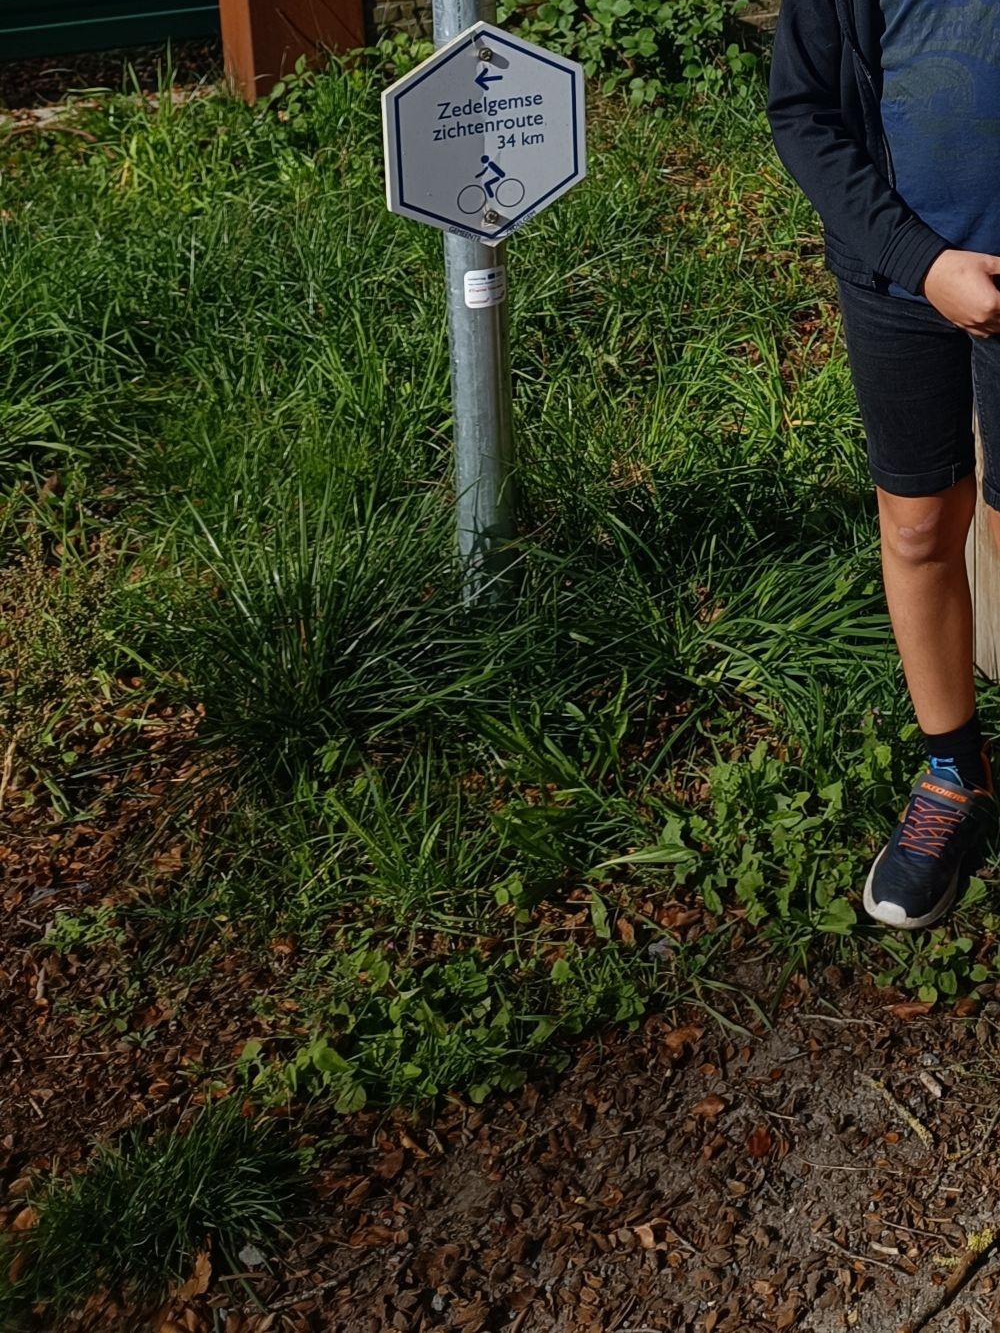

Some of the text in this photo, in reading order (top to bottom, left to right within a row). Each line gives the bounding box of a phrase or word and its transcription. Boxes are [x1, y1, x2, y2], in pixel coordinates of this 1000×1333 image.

[436, 93, 543, 121] Zedelgemse
[432, 113, 544, 142] zichtenroute
[497, 131, 545, 150] 34 km
[920, 780, 968, 804] SKECHERS
